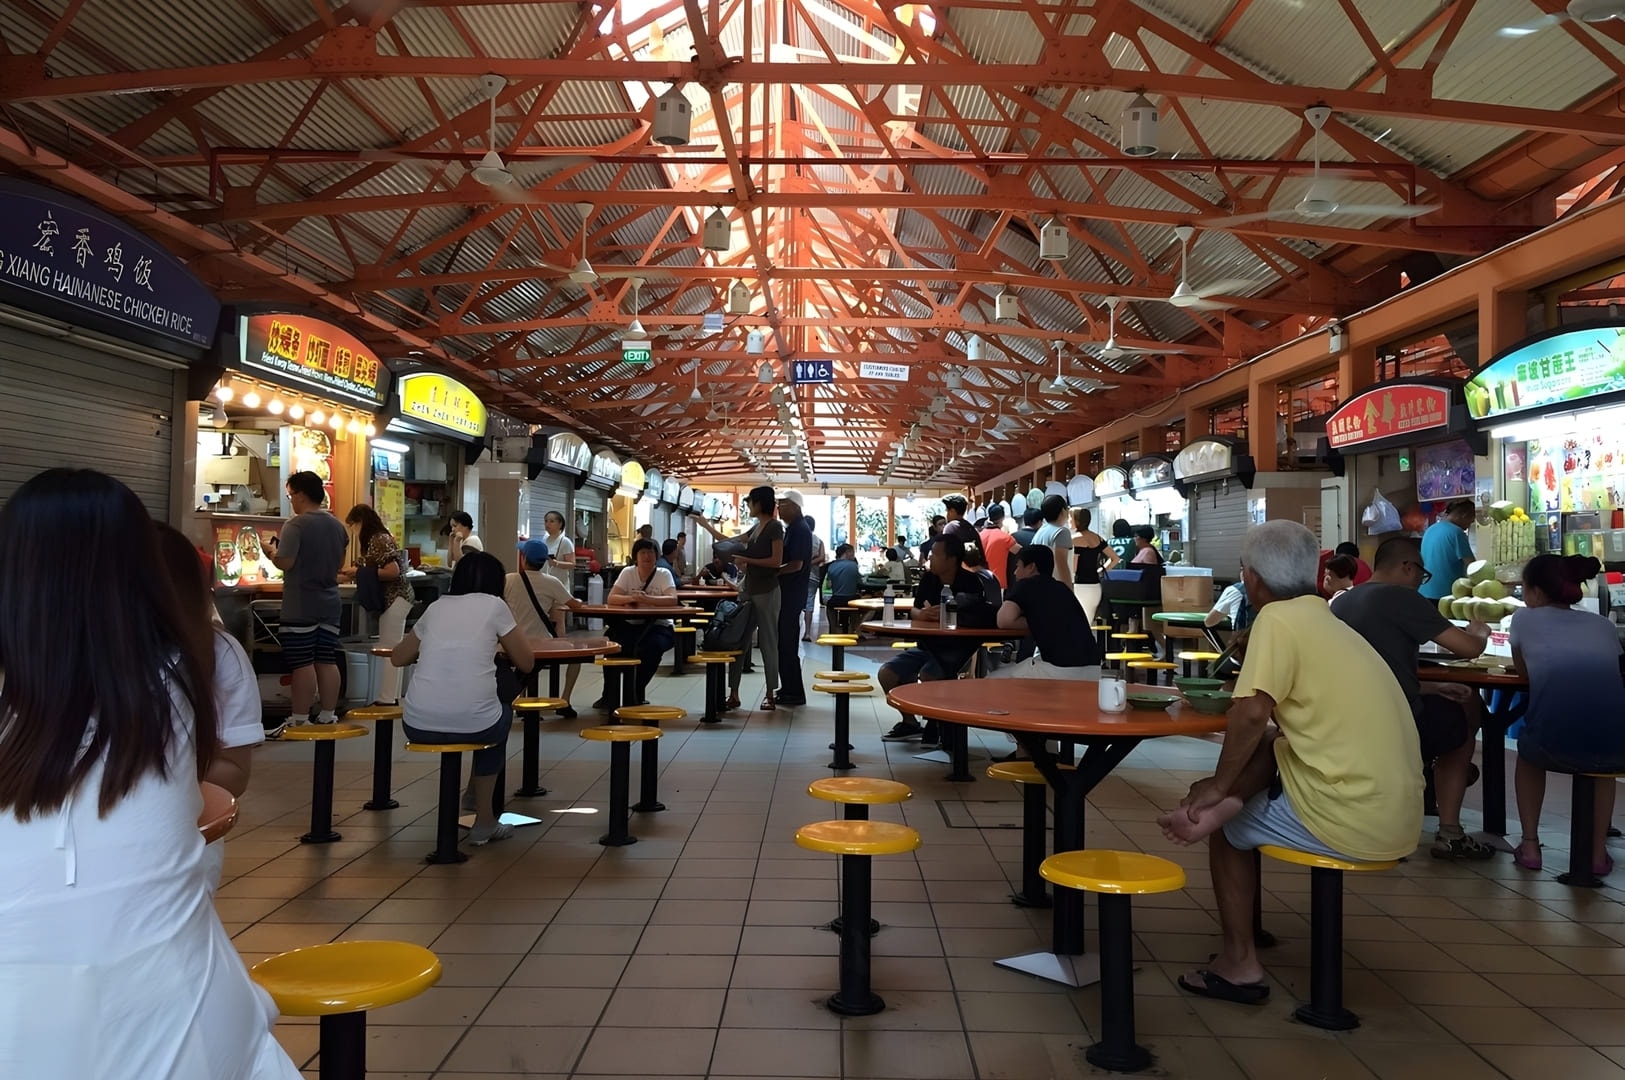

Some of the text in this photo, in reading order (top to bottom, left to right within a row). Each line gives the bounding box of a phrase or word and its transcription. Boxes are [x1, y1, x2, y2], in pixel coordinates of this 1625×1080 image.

[33, 210, 154, 292] 宏香鸡饭
[6, 254, 51, 286] XIANG
[53, 270, 122, 310] HAINANESE
[124, 296, 170, 327] CHICKEN
[171, 307, 193, 334] RICE
[627, 351, 646, 361] EXIT
[1107, 538, 1131, 546] ITALY
